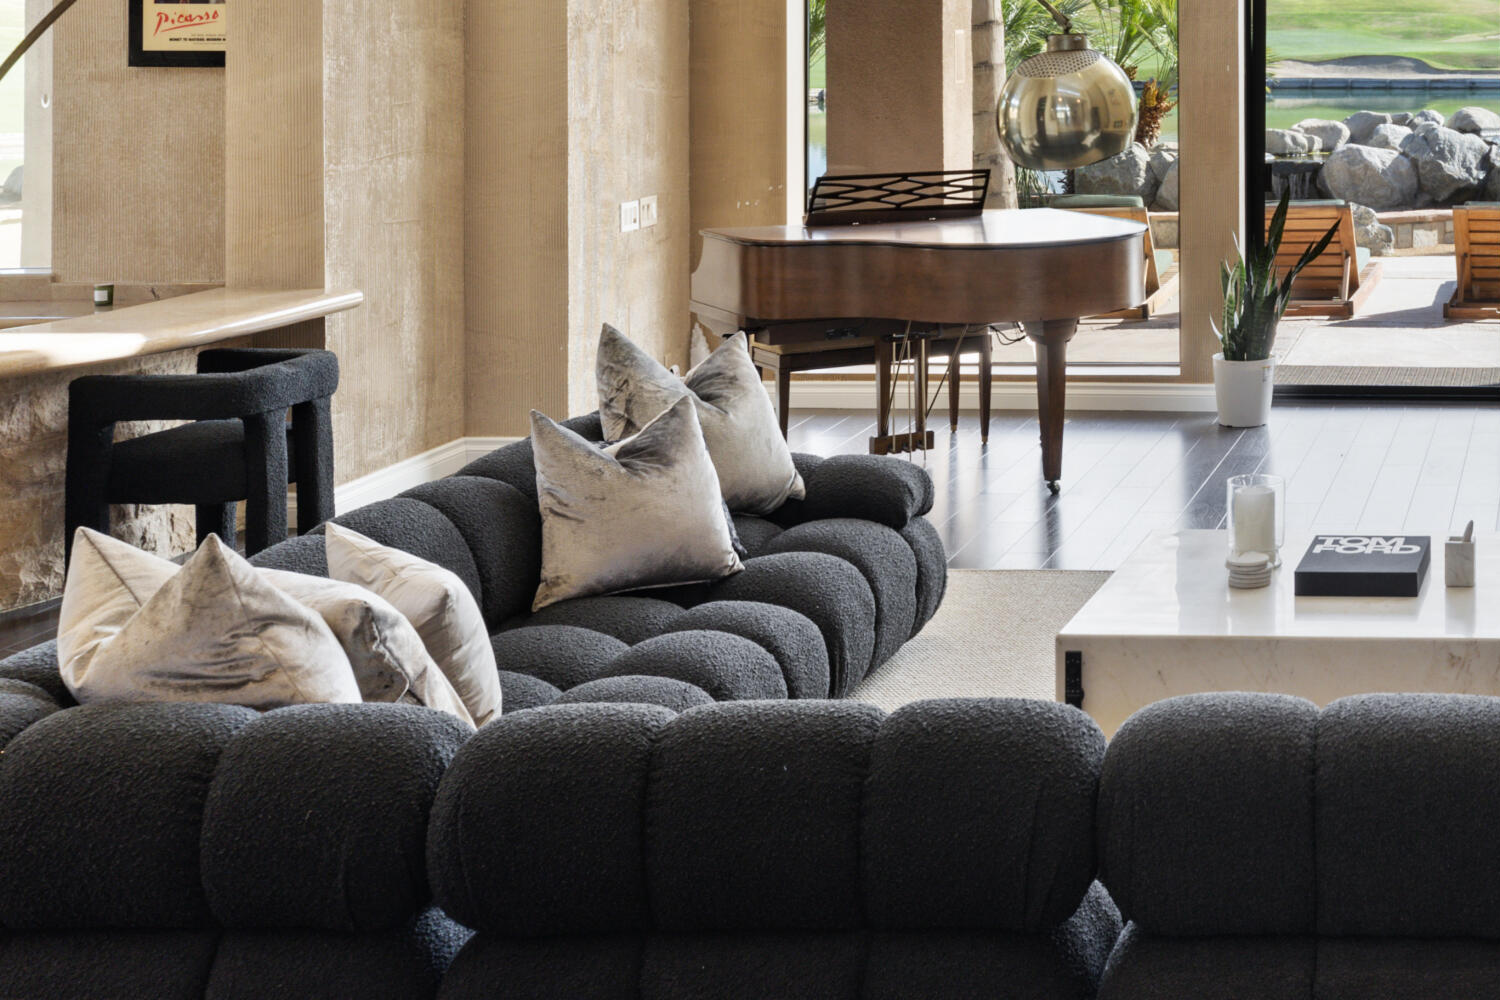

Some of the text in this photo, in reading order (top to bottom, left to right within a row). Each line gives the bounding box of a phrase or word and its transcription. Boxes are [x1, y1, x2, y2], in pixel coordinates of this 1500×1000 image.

[152, 10, 219, 36] Picasso
[1318, 536, 1405, 546] TOM
[1312, 544, 1421, 554] FORD
